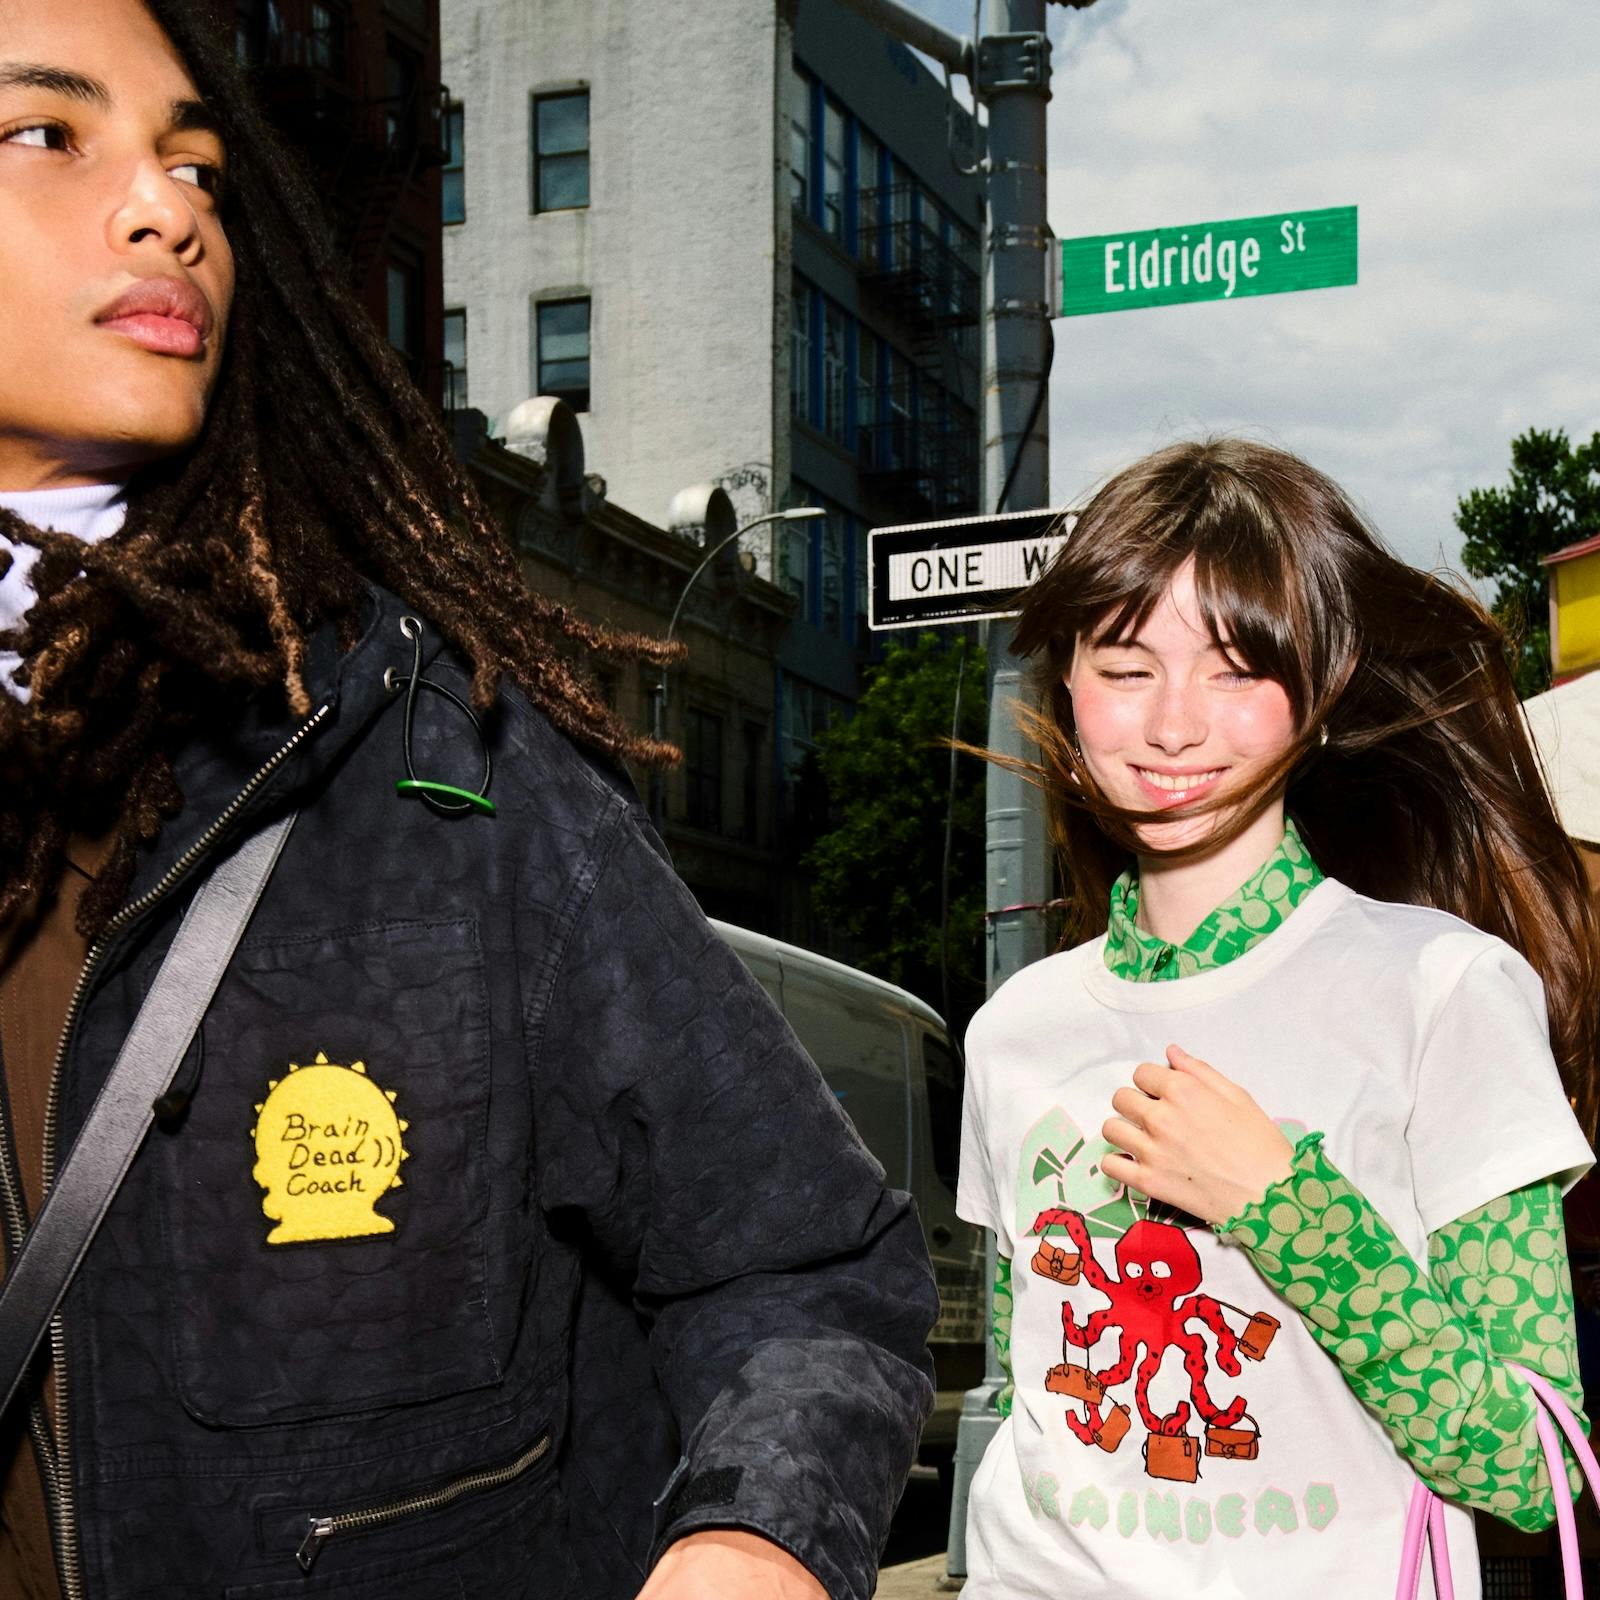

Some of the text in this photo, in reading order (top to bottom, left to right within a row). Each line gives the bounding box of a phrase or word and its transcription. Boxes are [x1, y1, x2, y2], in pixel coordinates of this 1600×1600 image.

[1104, 219, 1307, 298] Eldridge St
[911, 551, 983, 592] ONE
[281, 1113, 370, 1143] Brain
[288, 1139, 365, 1170] Dead
[286, 1171, 366, 1197] Coach
